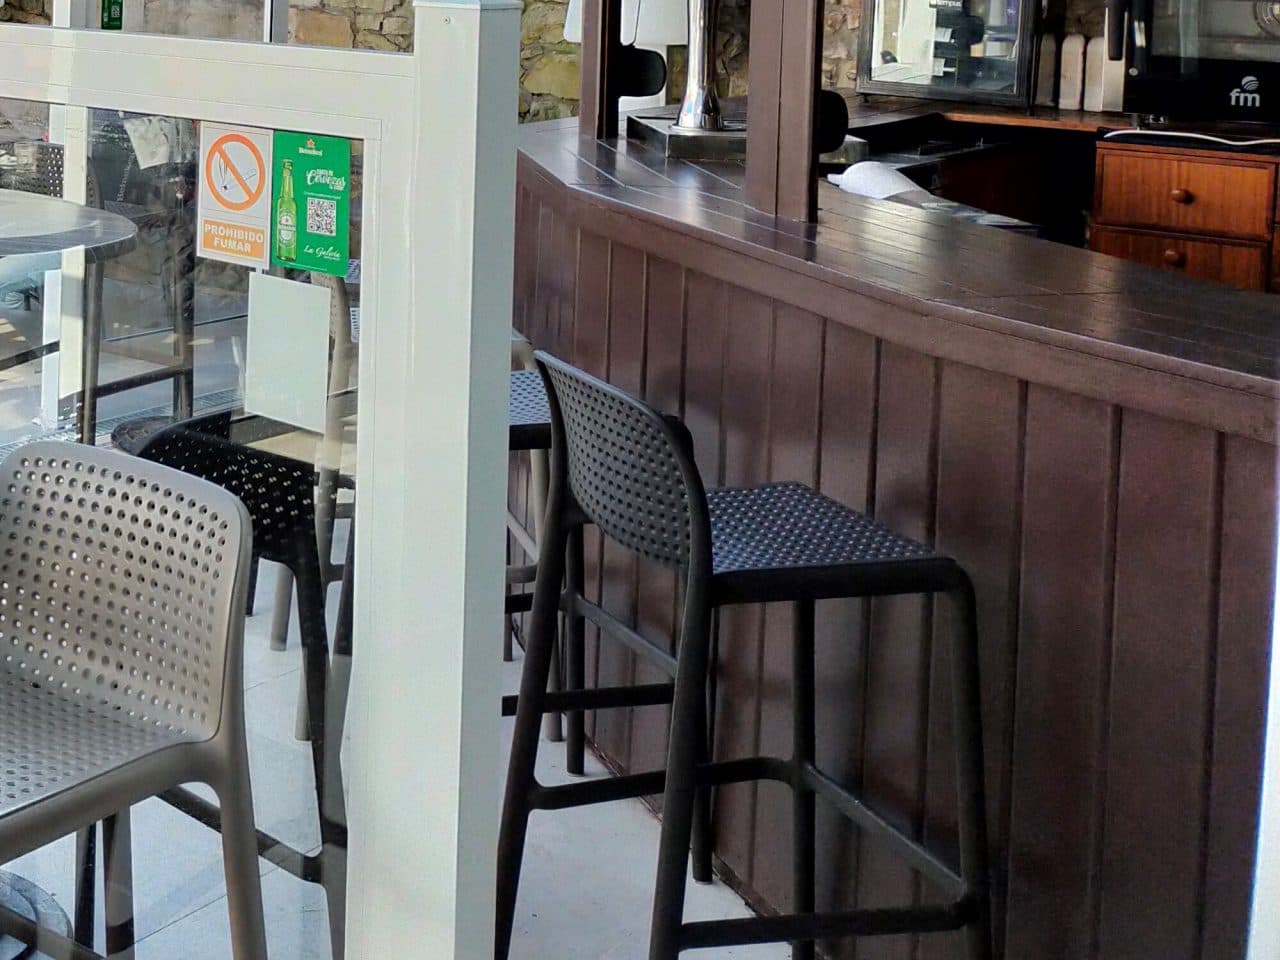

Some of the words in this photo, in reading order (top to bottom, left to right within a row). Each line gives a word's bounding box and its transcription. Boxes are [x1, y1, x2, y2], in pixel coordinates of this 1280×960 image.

[1230, 88, 1260, 107] fm
[204, 223, 264, 243] PROHIBIDO
[214, 237, 251, 253] FUMAR
